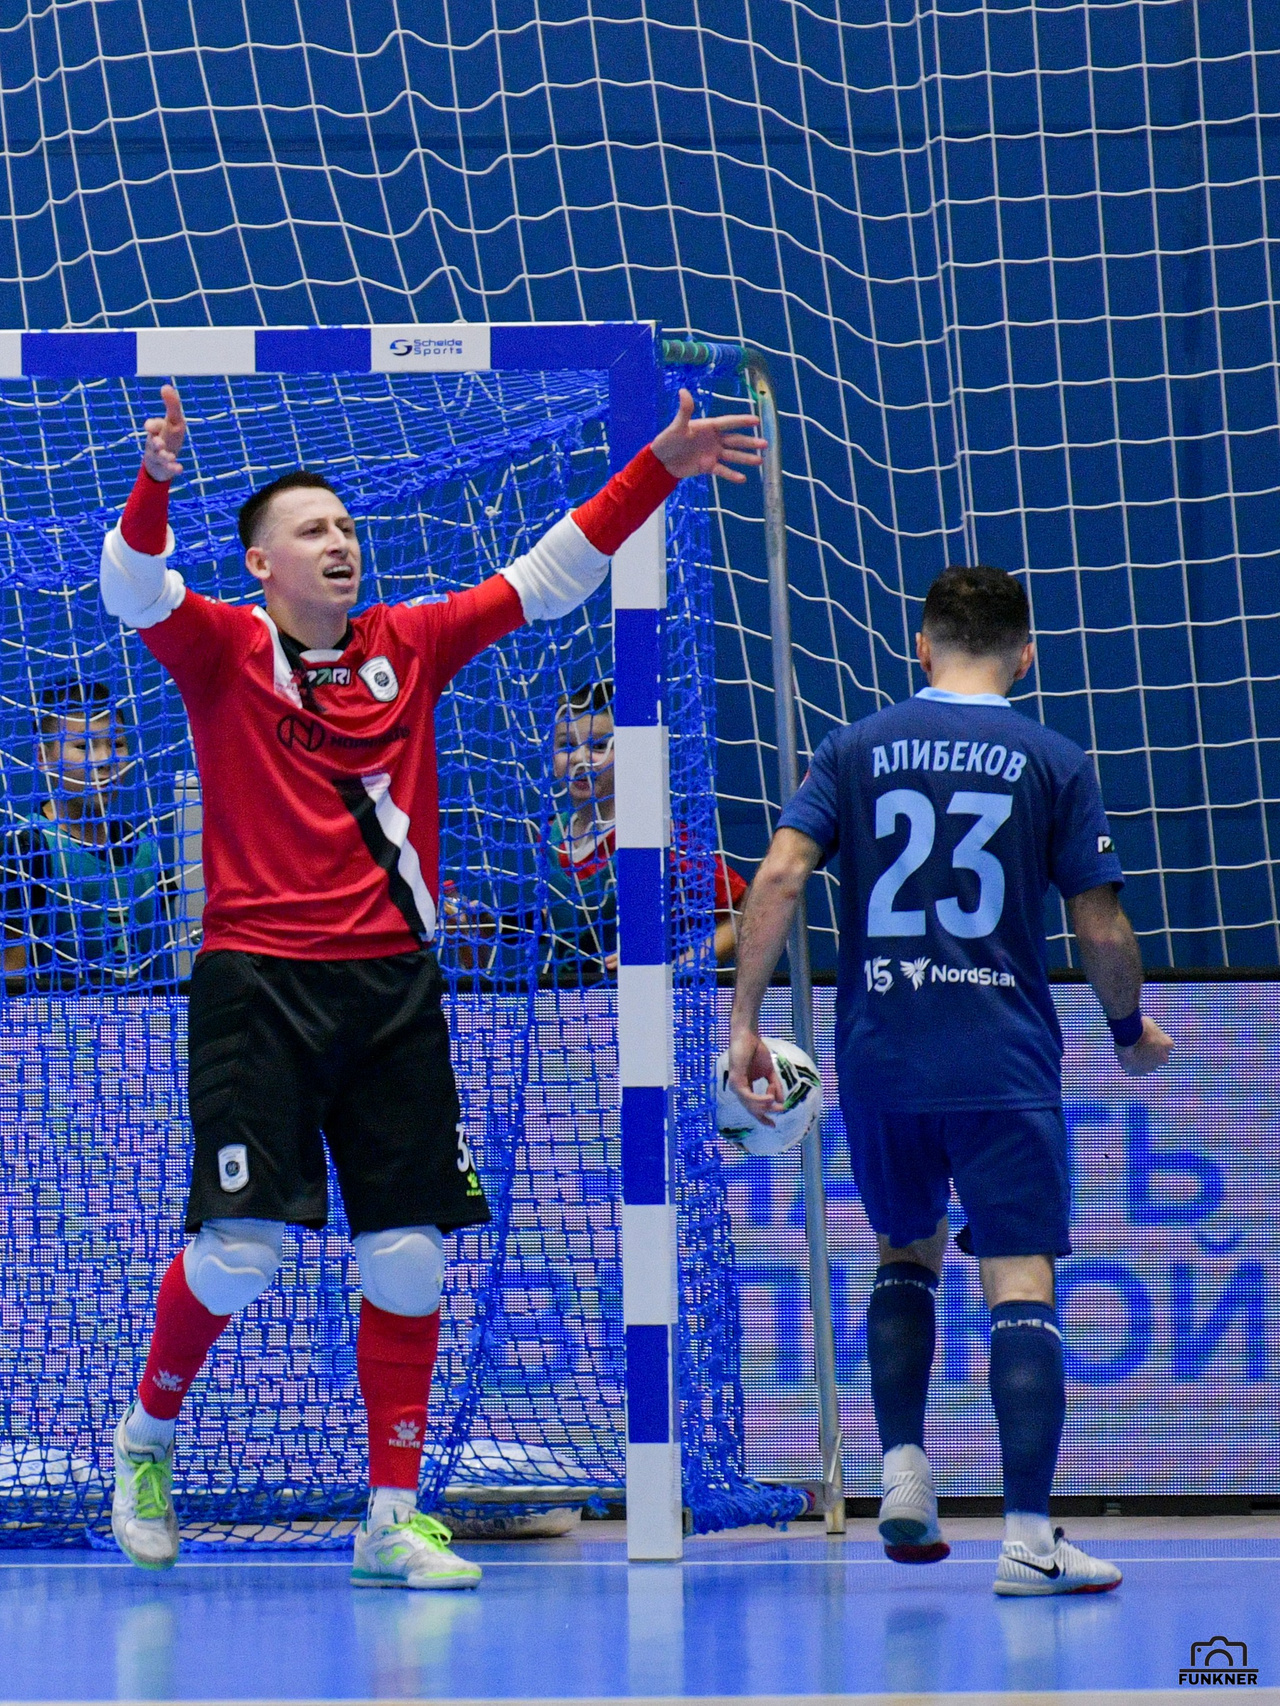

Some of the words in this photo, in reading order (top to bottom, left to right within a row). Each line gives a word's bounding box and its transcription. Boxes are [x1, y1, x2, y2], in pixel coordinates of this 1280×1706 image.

[413, 346, 463, 356] Sports
[872, 739, 1027, 783] АЛИБЕКОВ
[867, 788, 1013, 938] 23
[864, 956, 894, 995] 15
[455, 1123, 477, 1173] 3
